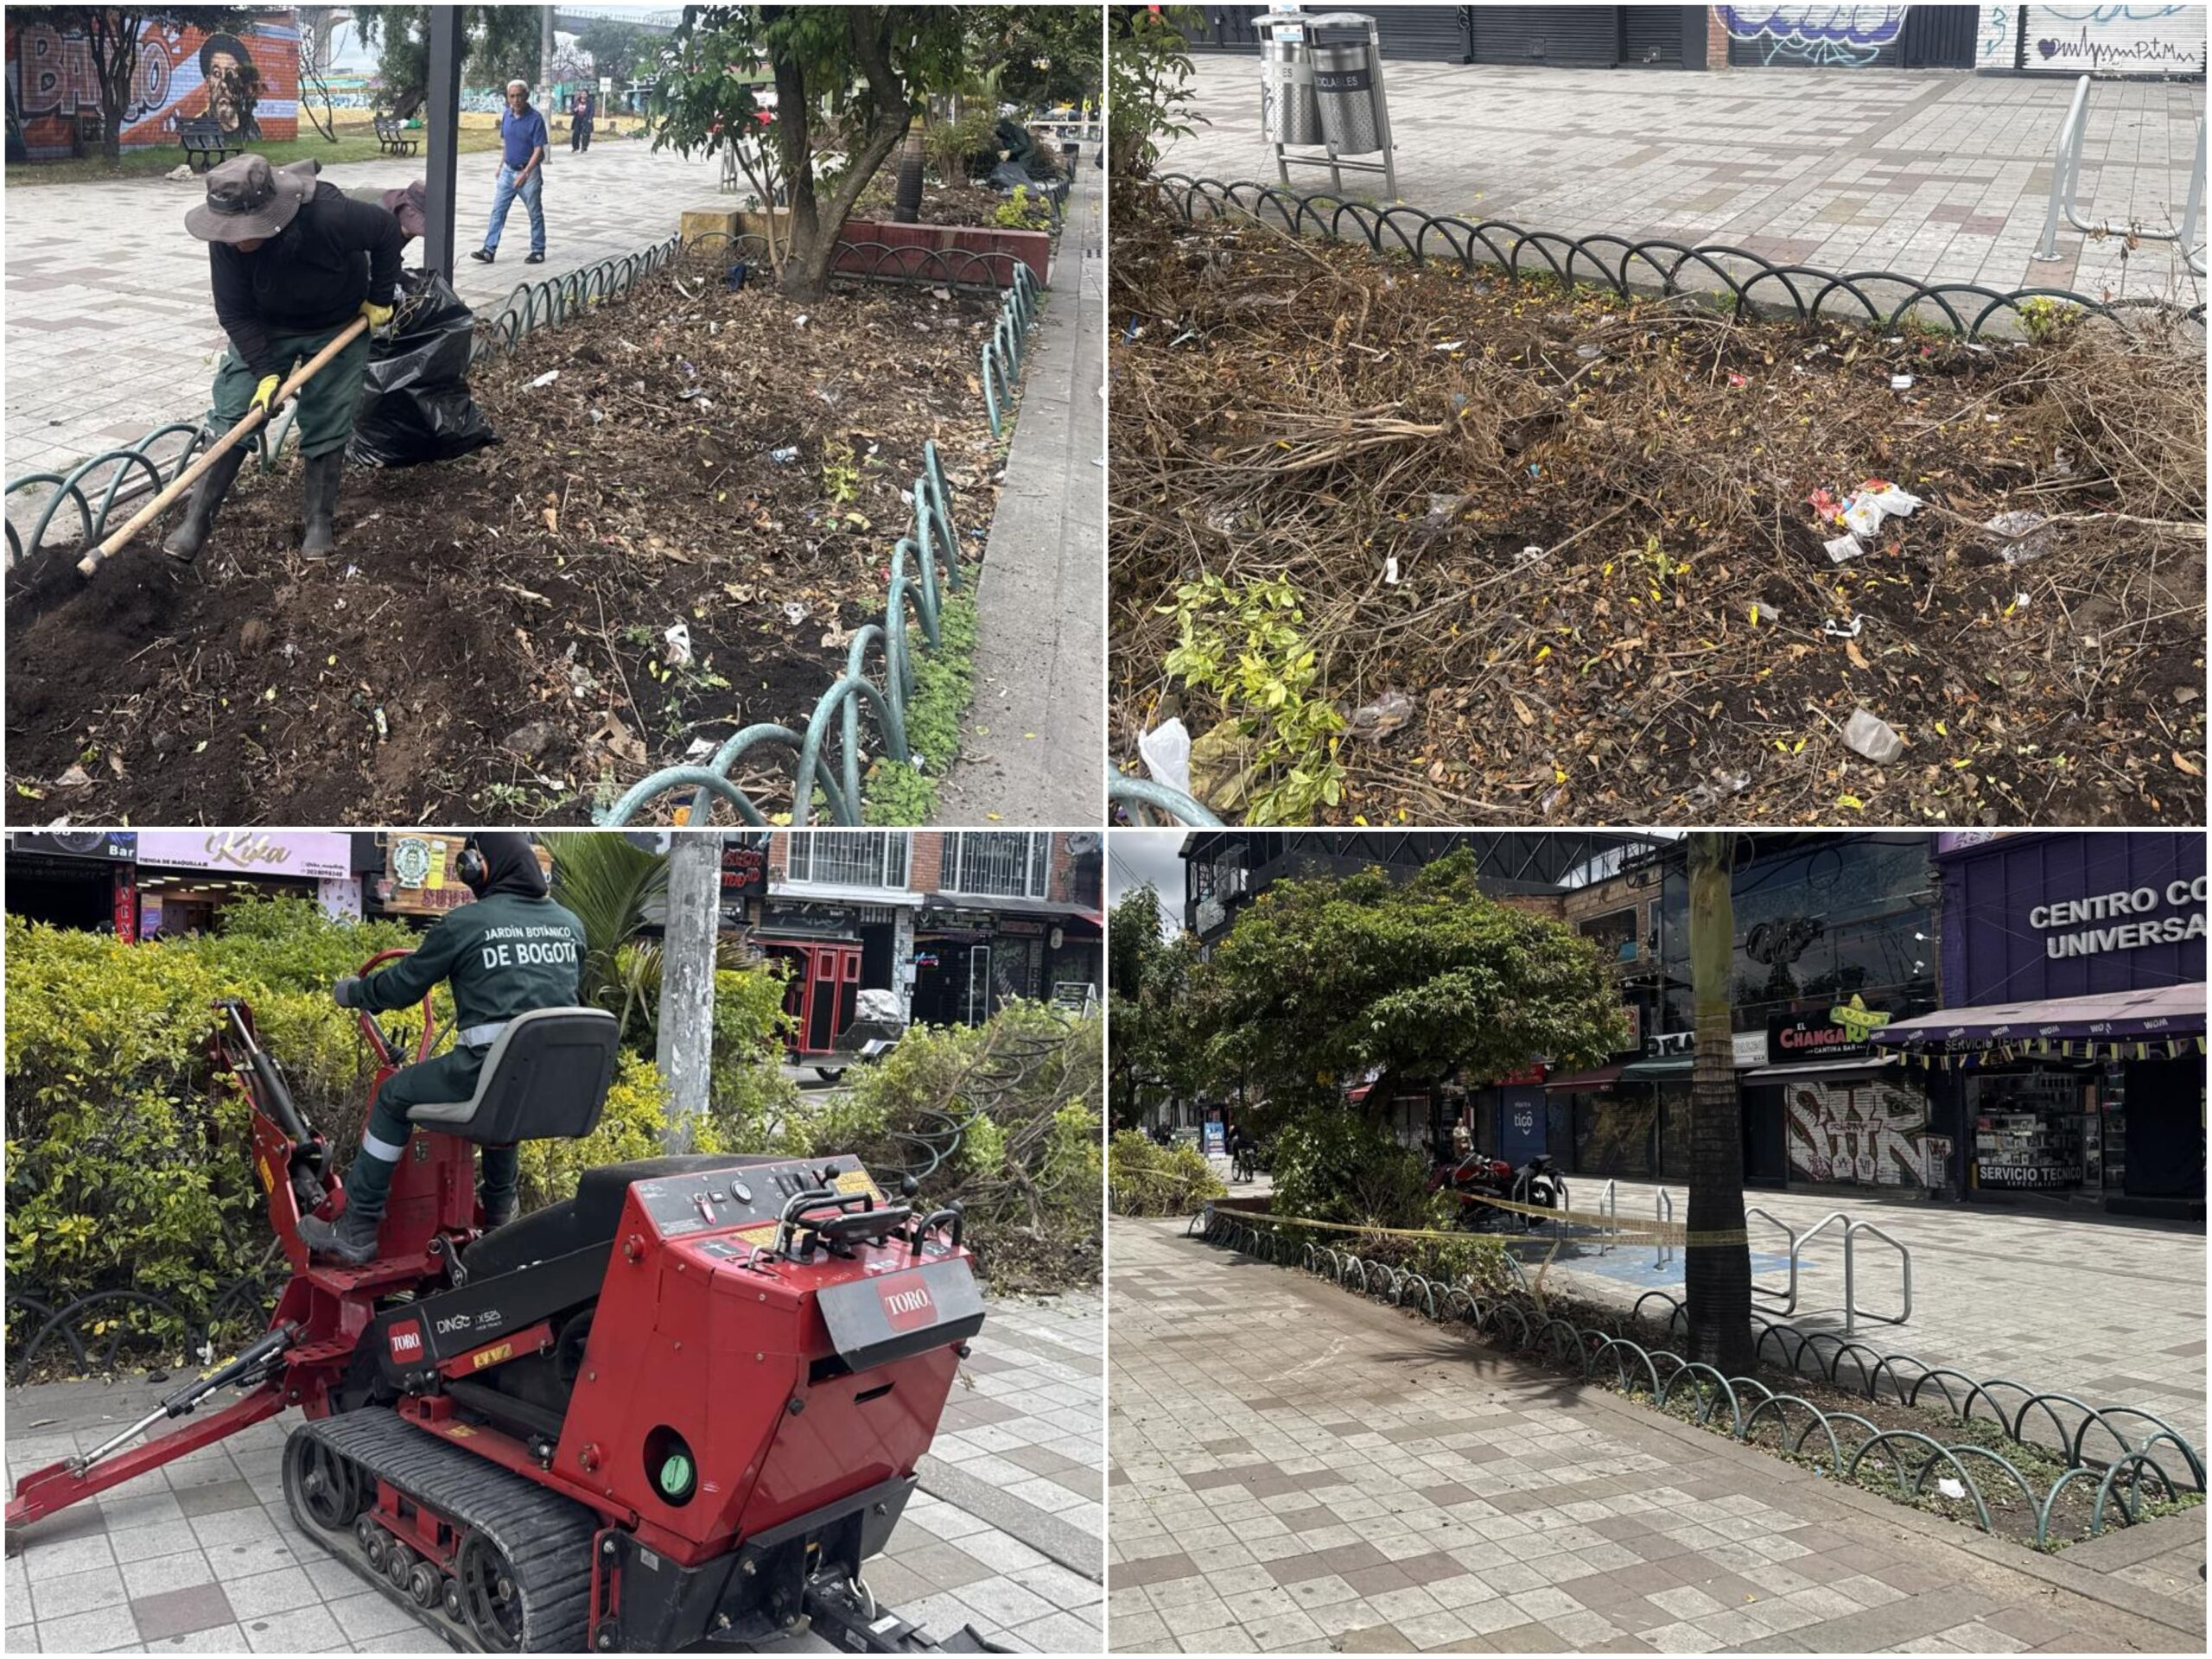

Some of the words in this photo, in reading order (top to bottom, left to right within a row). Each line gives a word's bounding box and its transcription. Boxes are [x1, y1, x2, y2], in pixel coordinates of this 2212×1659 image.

[109, 845, 134, 857] Bar
[2030, 887, 2159, 929] CENTRO
[2047, 912, 2207, 959] UNIVERSA
[482, 944, 512, 969] DE
[1797, 1022, 1806, 1031] EL
[1947, 1027, 1966, 1039] WOM
[1990, 1025, 2011, 1037] WOM
[2038, 1024, 2061, 1037] WOM
[2143, 1017, 2170, 1030] WOM
[1814, 1045, 1841, 1054] CANTINA
[1945, 1038, 1993, 1052] SERVICIO
[1979, 1166, 2038, 1181] SERVICIO
[885, 1287, 929, 1315] TORO
[391, 1332, 421, 1351] TORO
